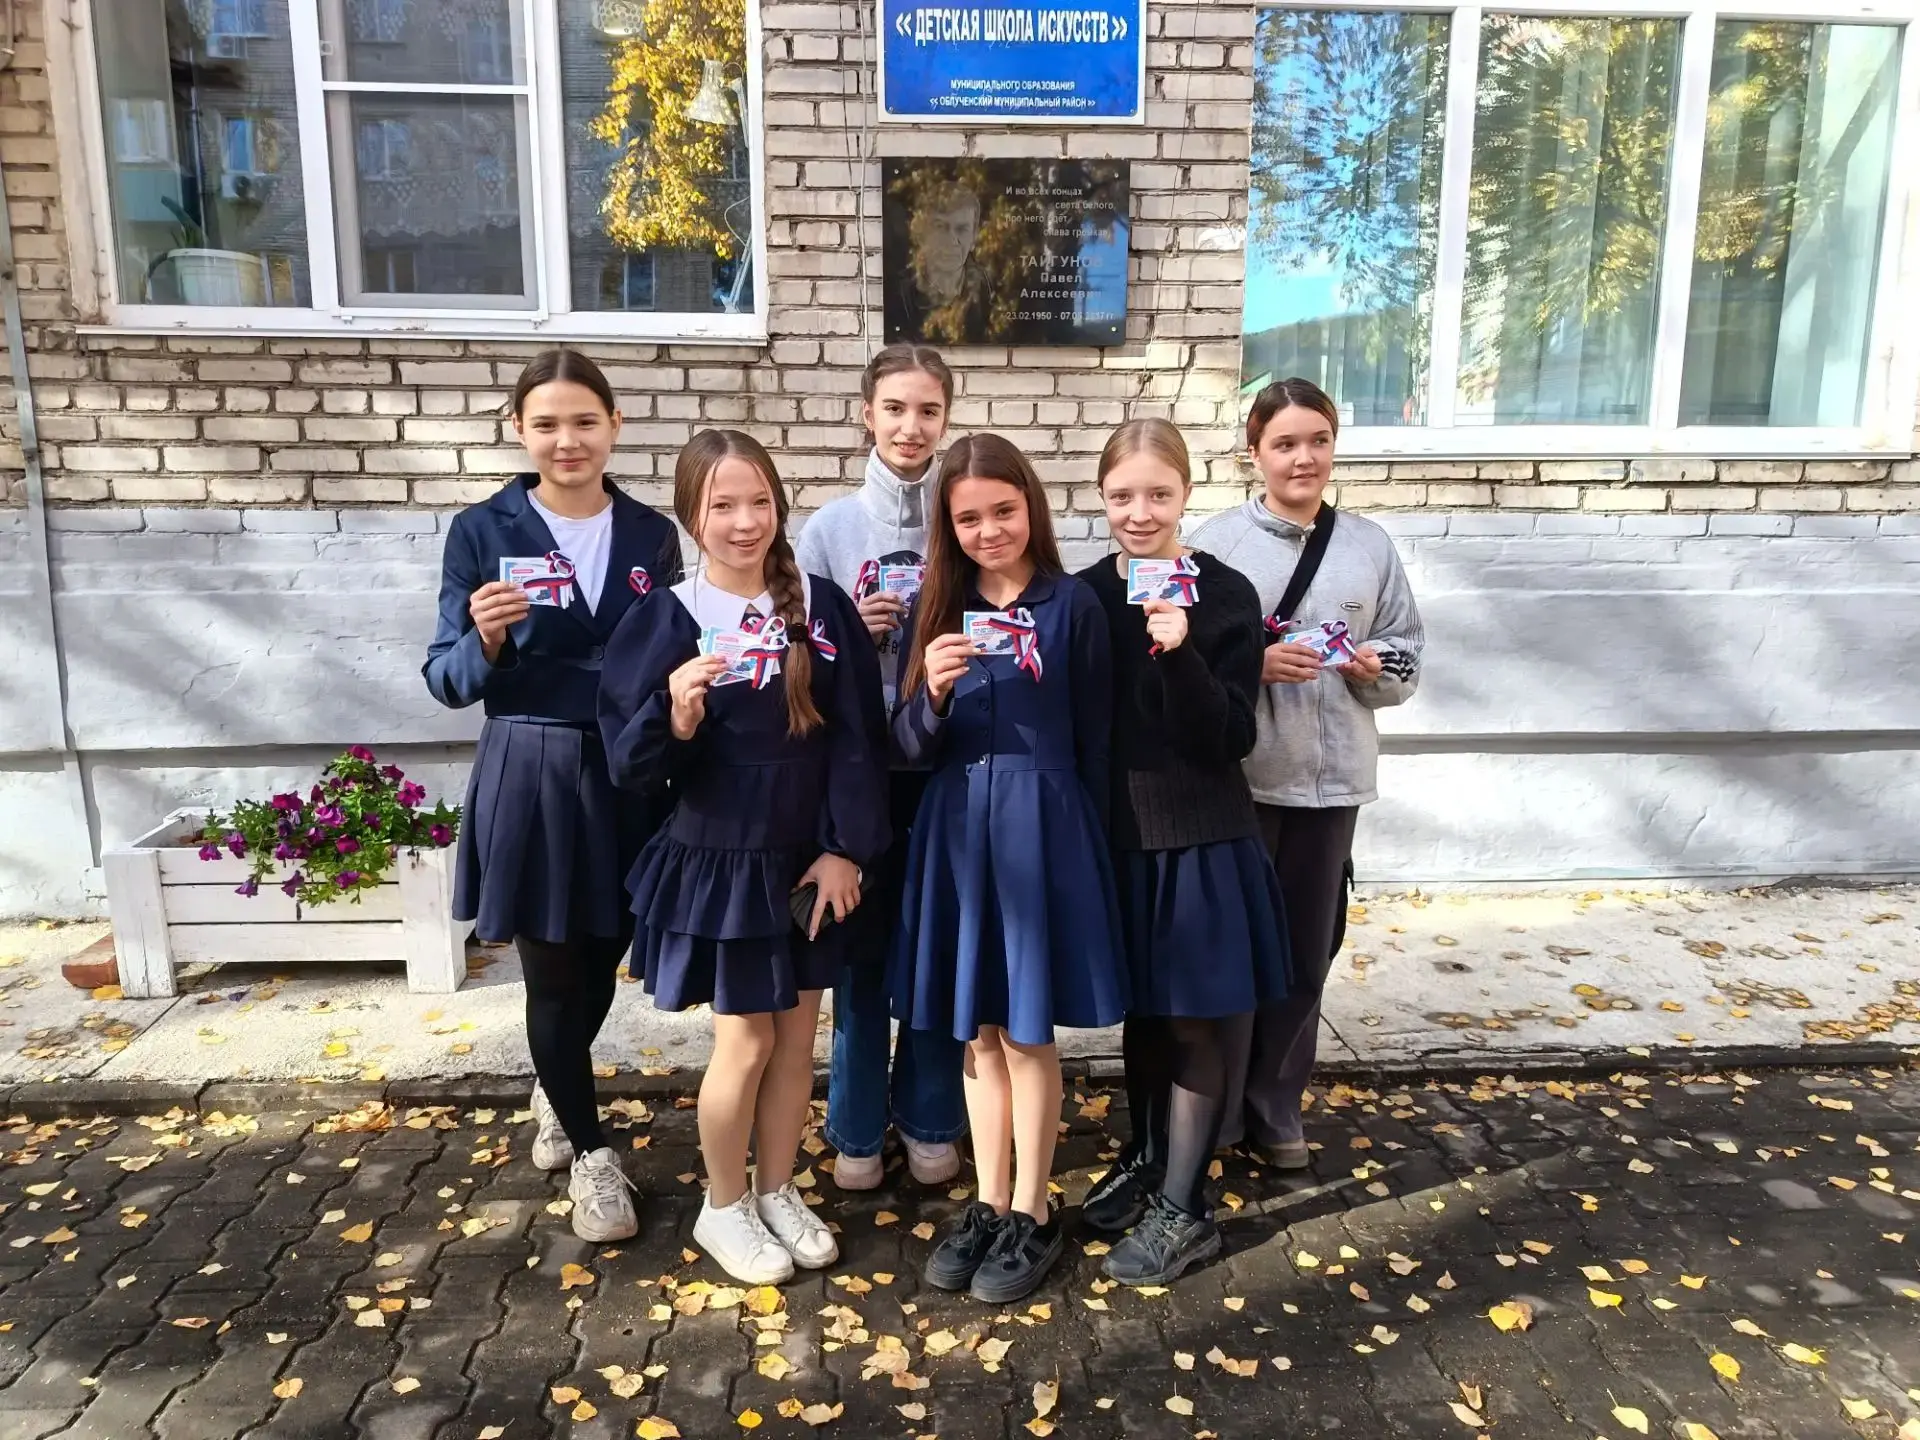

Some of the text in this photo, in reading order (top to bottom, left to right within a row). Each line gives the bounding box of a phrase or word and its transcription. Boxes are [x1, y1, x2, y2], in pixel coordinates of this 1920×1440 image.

[983, 8, 1034, 42] ШКОЛА
[950, 79, 1075, 91] МУНИЦИПАЛЬНОГО ОБРАЗОВАНИЯ
[993, 96, 1061, 108] МУНИЦИПАЛЬНЫЙ
[1005, 186, 1083, 197] И во всех концах
[1055, 202, 1080, 210] света
[1024, 215, 1045, 223] него
[1041, 272, 1082, 283] Павел
[1006, 311, 1052, 320] 23.02.1950
